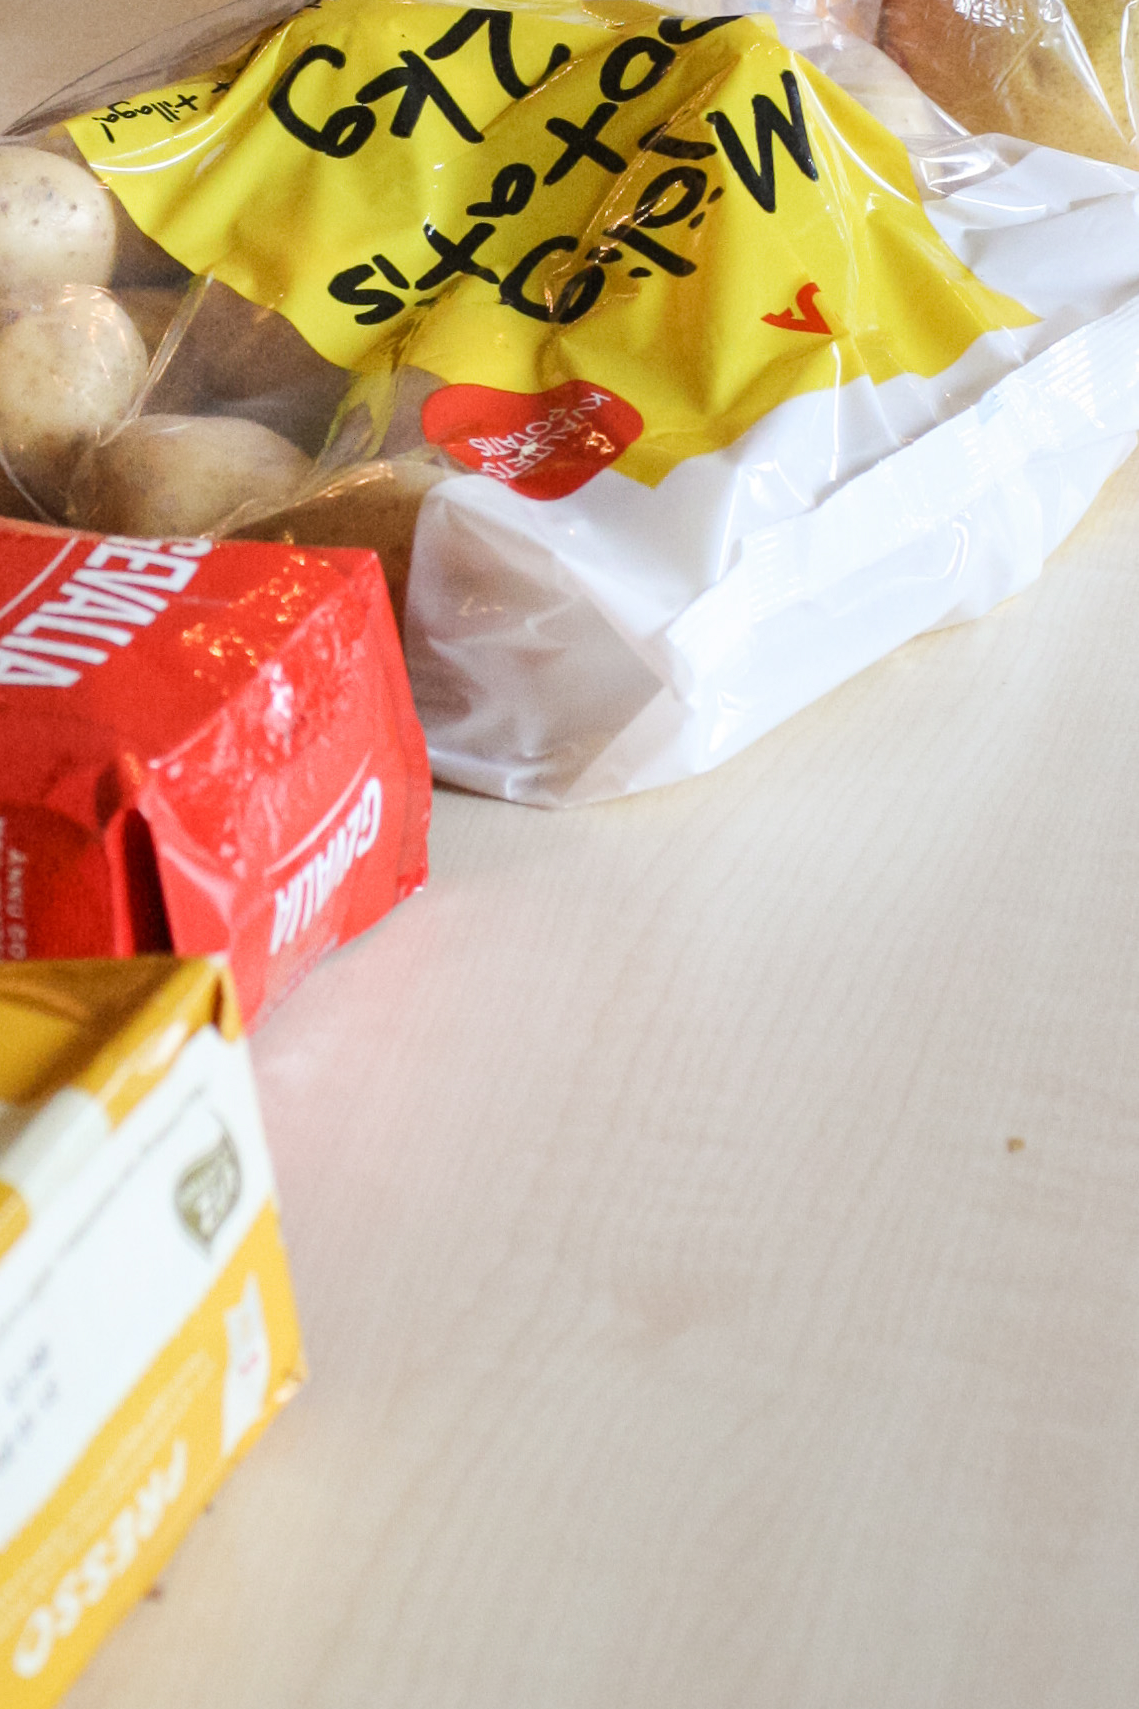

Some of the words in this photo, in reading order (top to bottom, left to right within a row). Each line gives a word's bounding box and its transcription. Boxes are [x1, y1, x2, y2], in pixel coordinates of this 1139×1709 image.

[92, 92, 200, 144] tillaga!
[498, 69, 819, 325] Mjölig
[468, 407, 568, 458] POTATIS
[269, 777, 383, 956] GEVALIA
